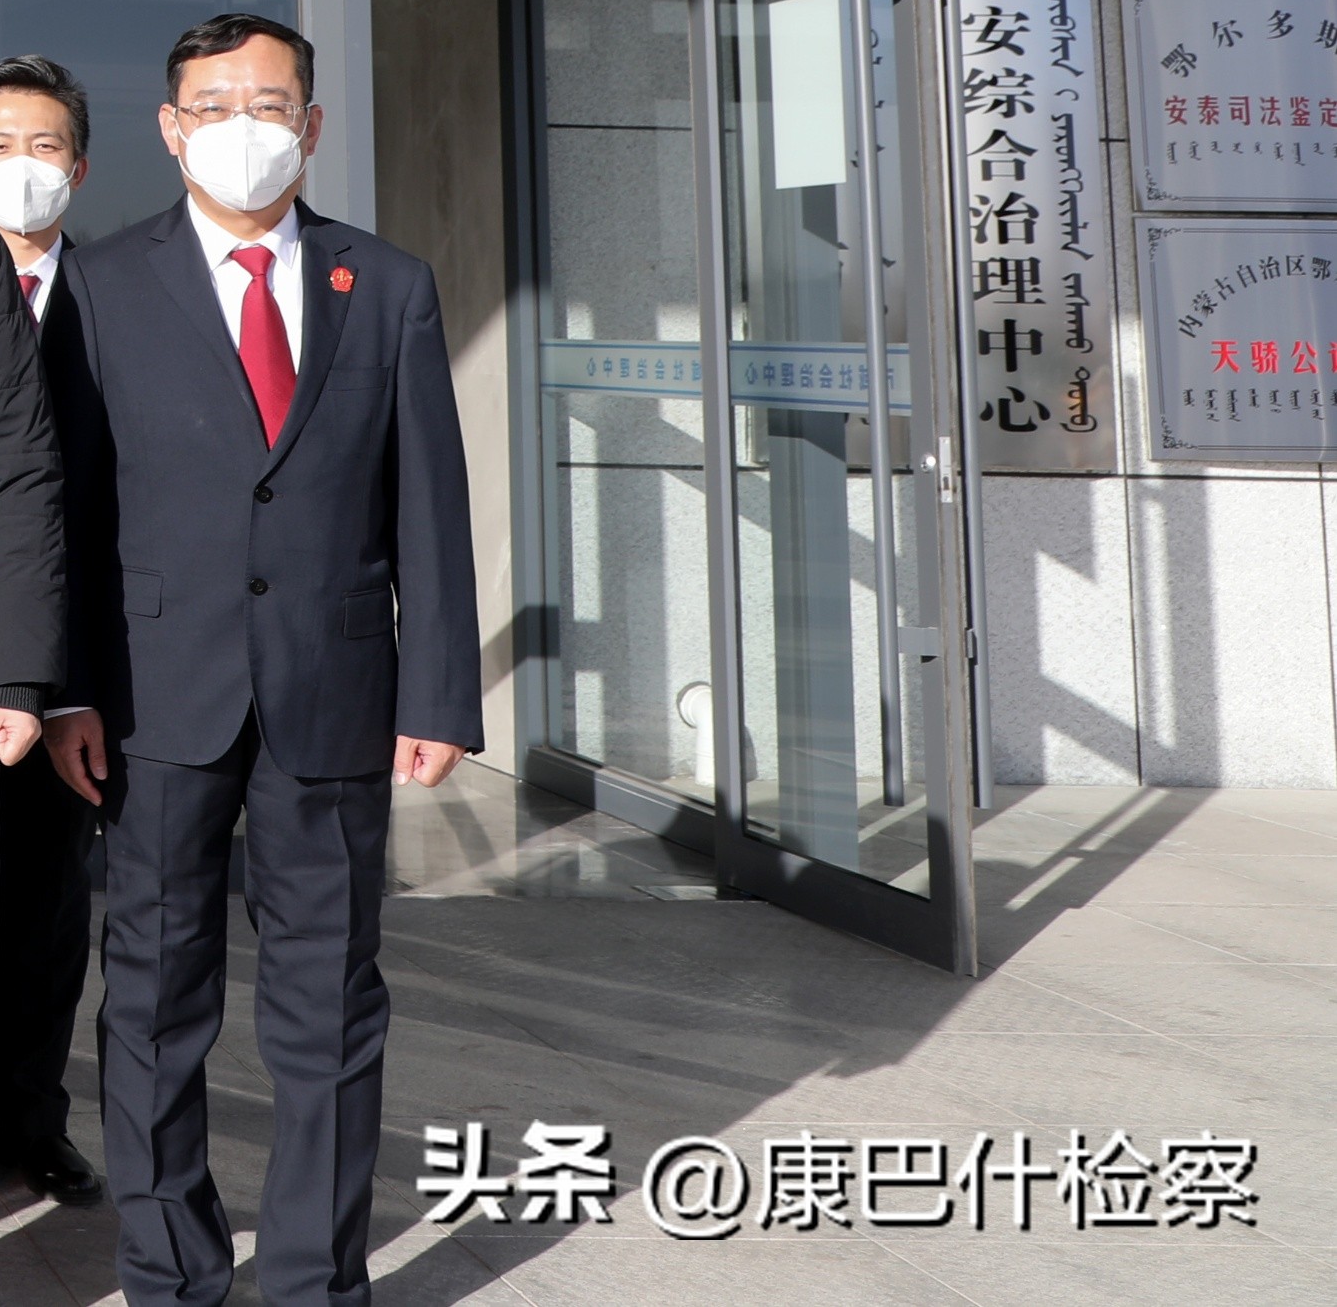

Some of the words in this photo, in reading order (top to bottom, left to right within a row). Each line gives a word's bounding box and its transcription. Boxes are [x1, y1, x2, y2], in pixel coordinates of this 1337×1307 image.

[1164, 95, 1337, 127] 安泰司法鉴定
[1178, 254, 1337, 338] 内蒙古自治区鄂
